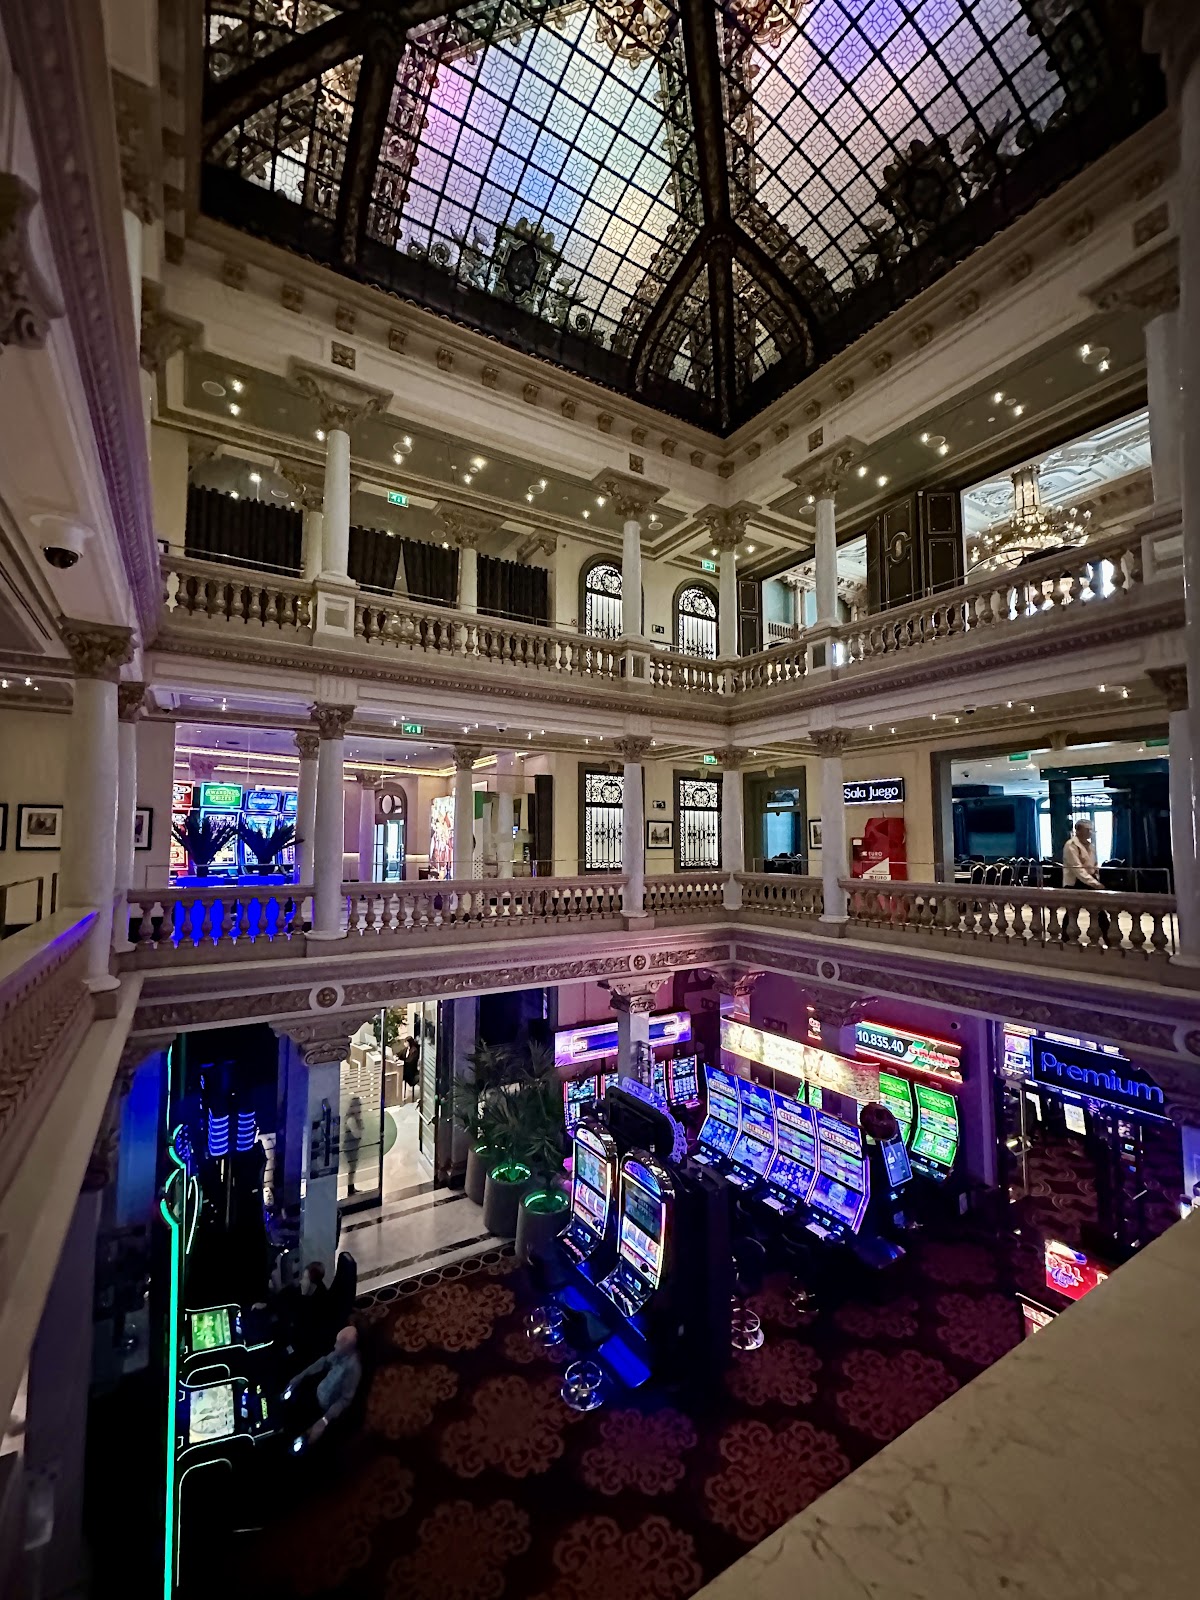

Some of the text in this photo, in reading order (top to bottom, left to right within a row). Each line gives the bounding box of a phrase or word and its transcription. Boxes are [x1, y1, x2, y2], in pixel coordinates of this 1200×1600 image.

[844, 785, 899, 801] Sala Juego
[857, 1029, 905, 1054] 10.835,40
[908, 1045, 961, 1068] GRAND
[1040, 1051, 1164, 1104] Premium
